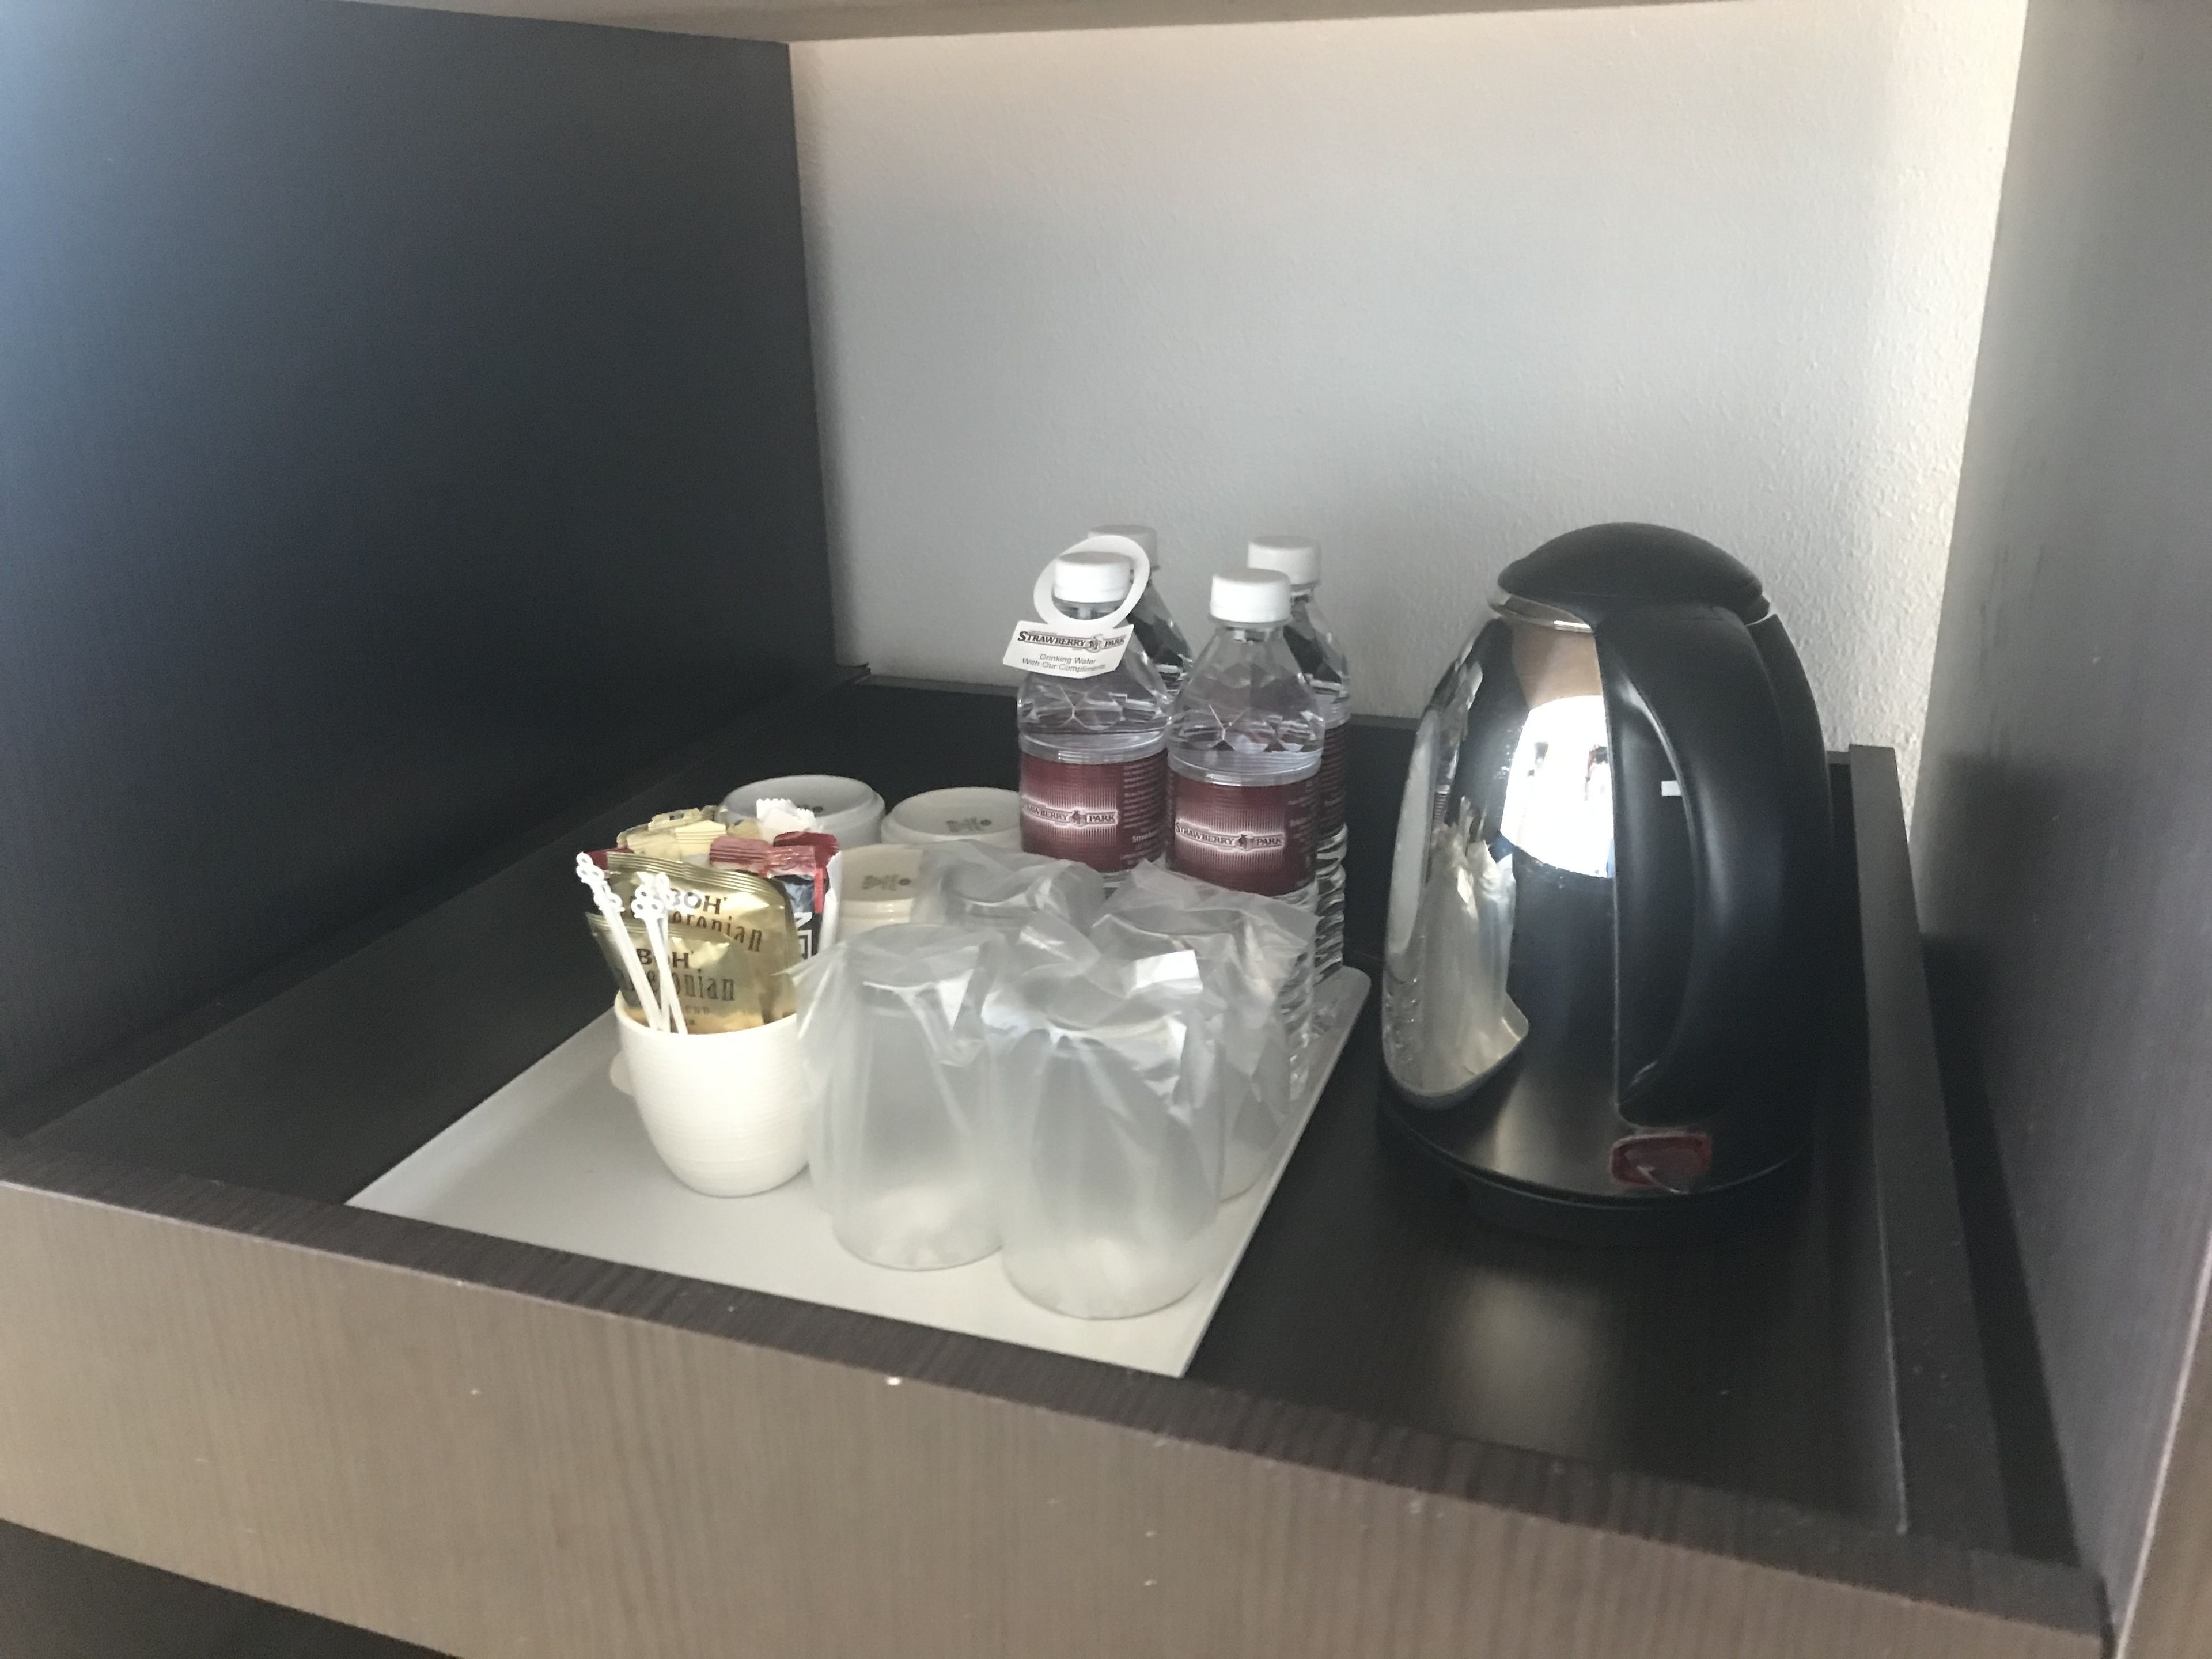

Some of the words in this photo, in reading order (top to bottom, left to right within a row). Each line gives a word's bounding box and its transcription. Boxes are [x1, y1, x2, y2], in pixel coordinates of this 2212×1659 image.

[1017, 631, 1085, 647] STRAWBERRY
[1104, 638, 1124, 647] PARK
[1022, 658, 1040, 666] With
[1039, 653, 1072, 664] Drinking
[1175, 821, 1234, 846] STRAWBERRY
[1256, 837, 1282, 846] PARK
